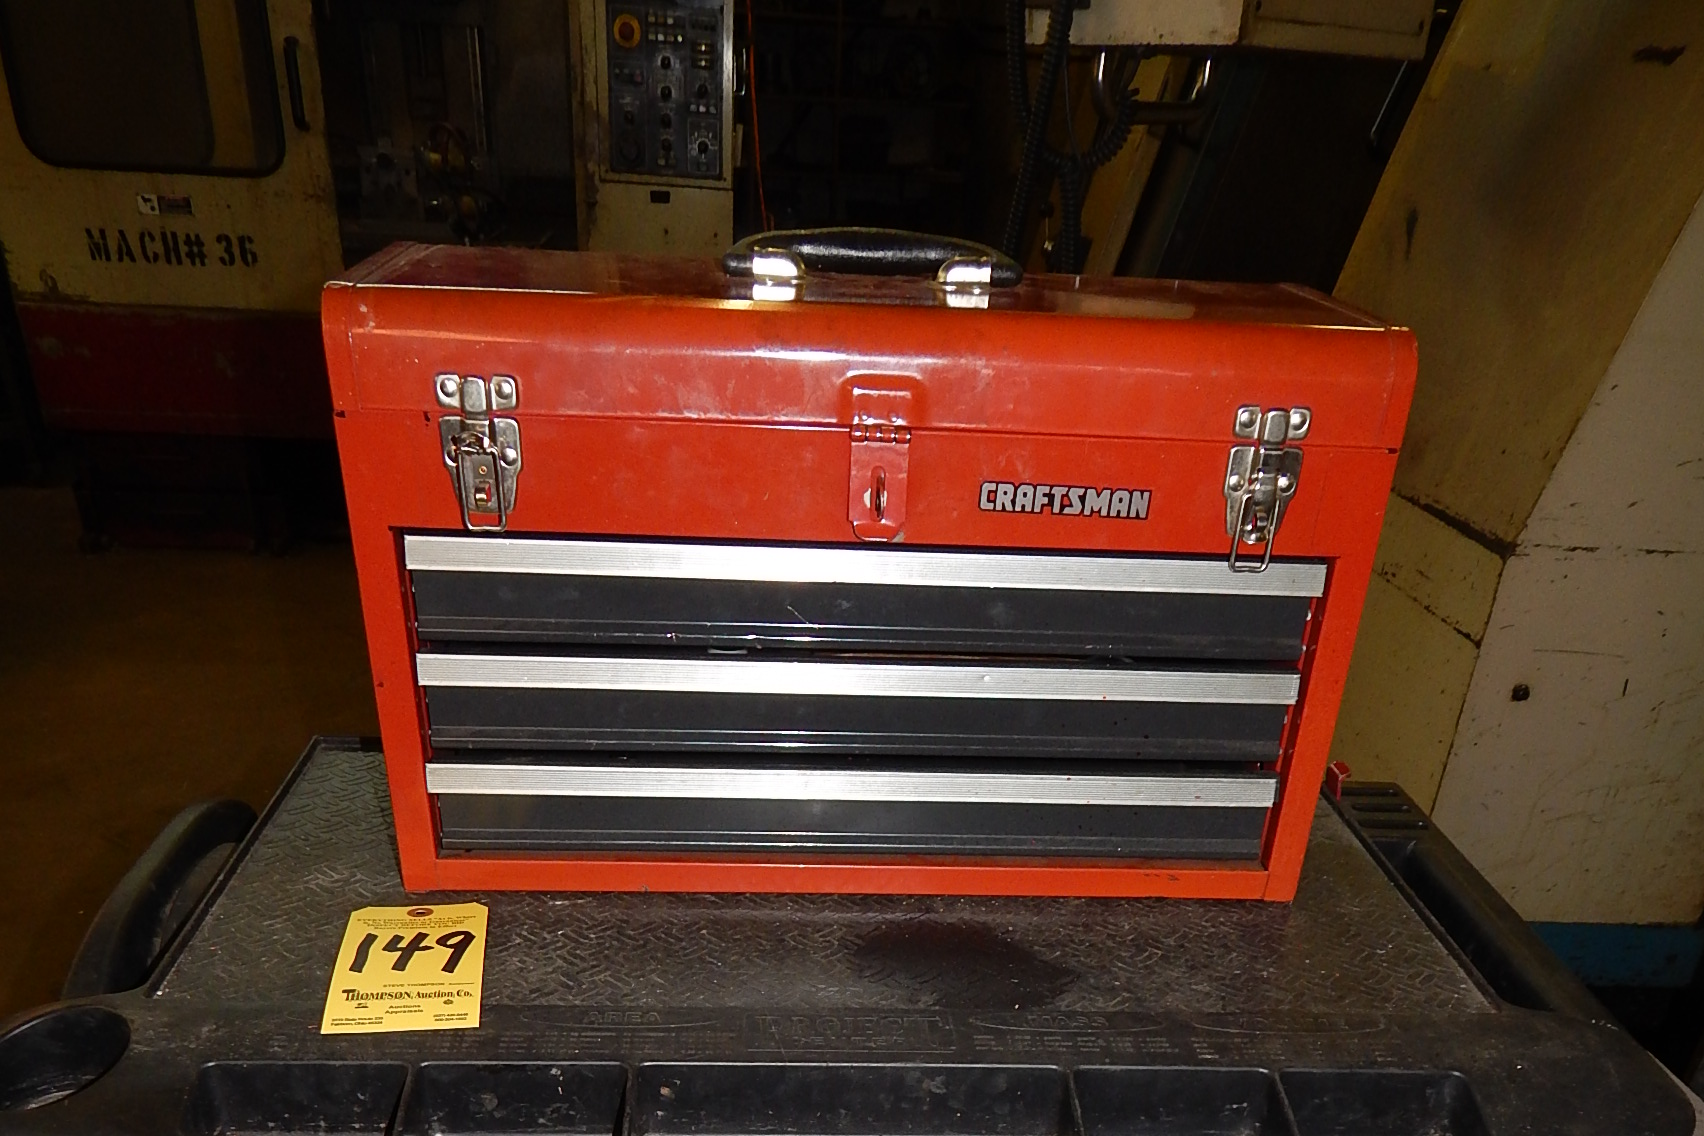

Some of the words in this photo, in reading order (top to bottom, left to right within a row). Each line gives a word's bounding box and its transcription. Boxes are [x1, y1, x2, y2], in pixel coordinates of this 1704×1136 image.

[85, 227, 207, 267] MACH#
[216, 233, 258, 267] 36
[979, 481, 1152, 520] CRAFTSMAN
[349, 931, 476, 973] 149
[342, 988, 413, 1002] THOMPSON
[415, 988, 455, 1000] Auction
